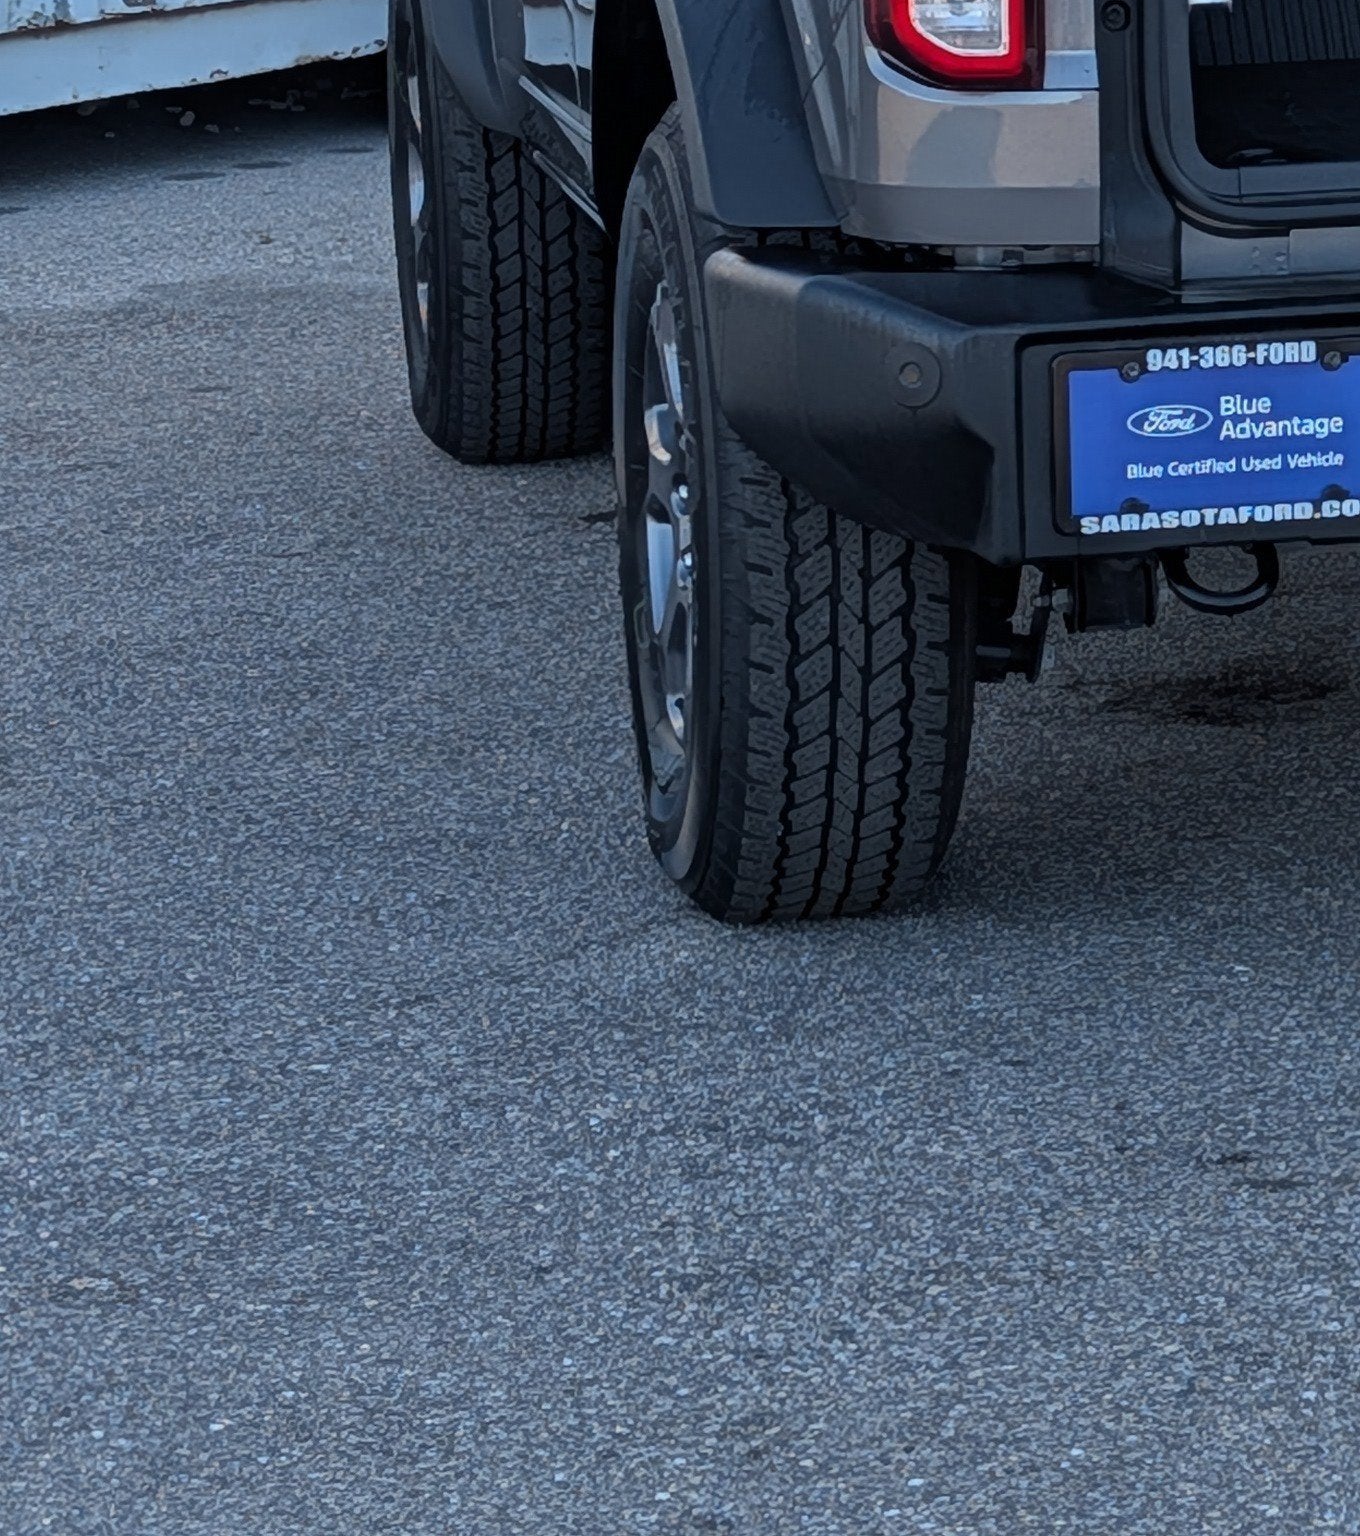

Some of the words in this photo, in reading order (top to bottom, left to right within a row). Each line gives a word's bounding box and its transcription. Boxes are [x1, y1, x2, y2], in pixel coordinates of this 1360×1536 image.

[1146, 340, 1318, 372] 941-366-FORD
[1219, 394, 1272, 416] Blue
[1219, 415, 1345, 441] Advantage
[1126, 462, 1164, 480] Blue
[1167, 457, 1236, 478] Certified
[1241, 453, 1282, 472] Used
[1287, 451, 1345, 469] Vehicle
